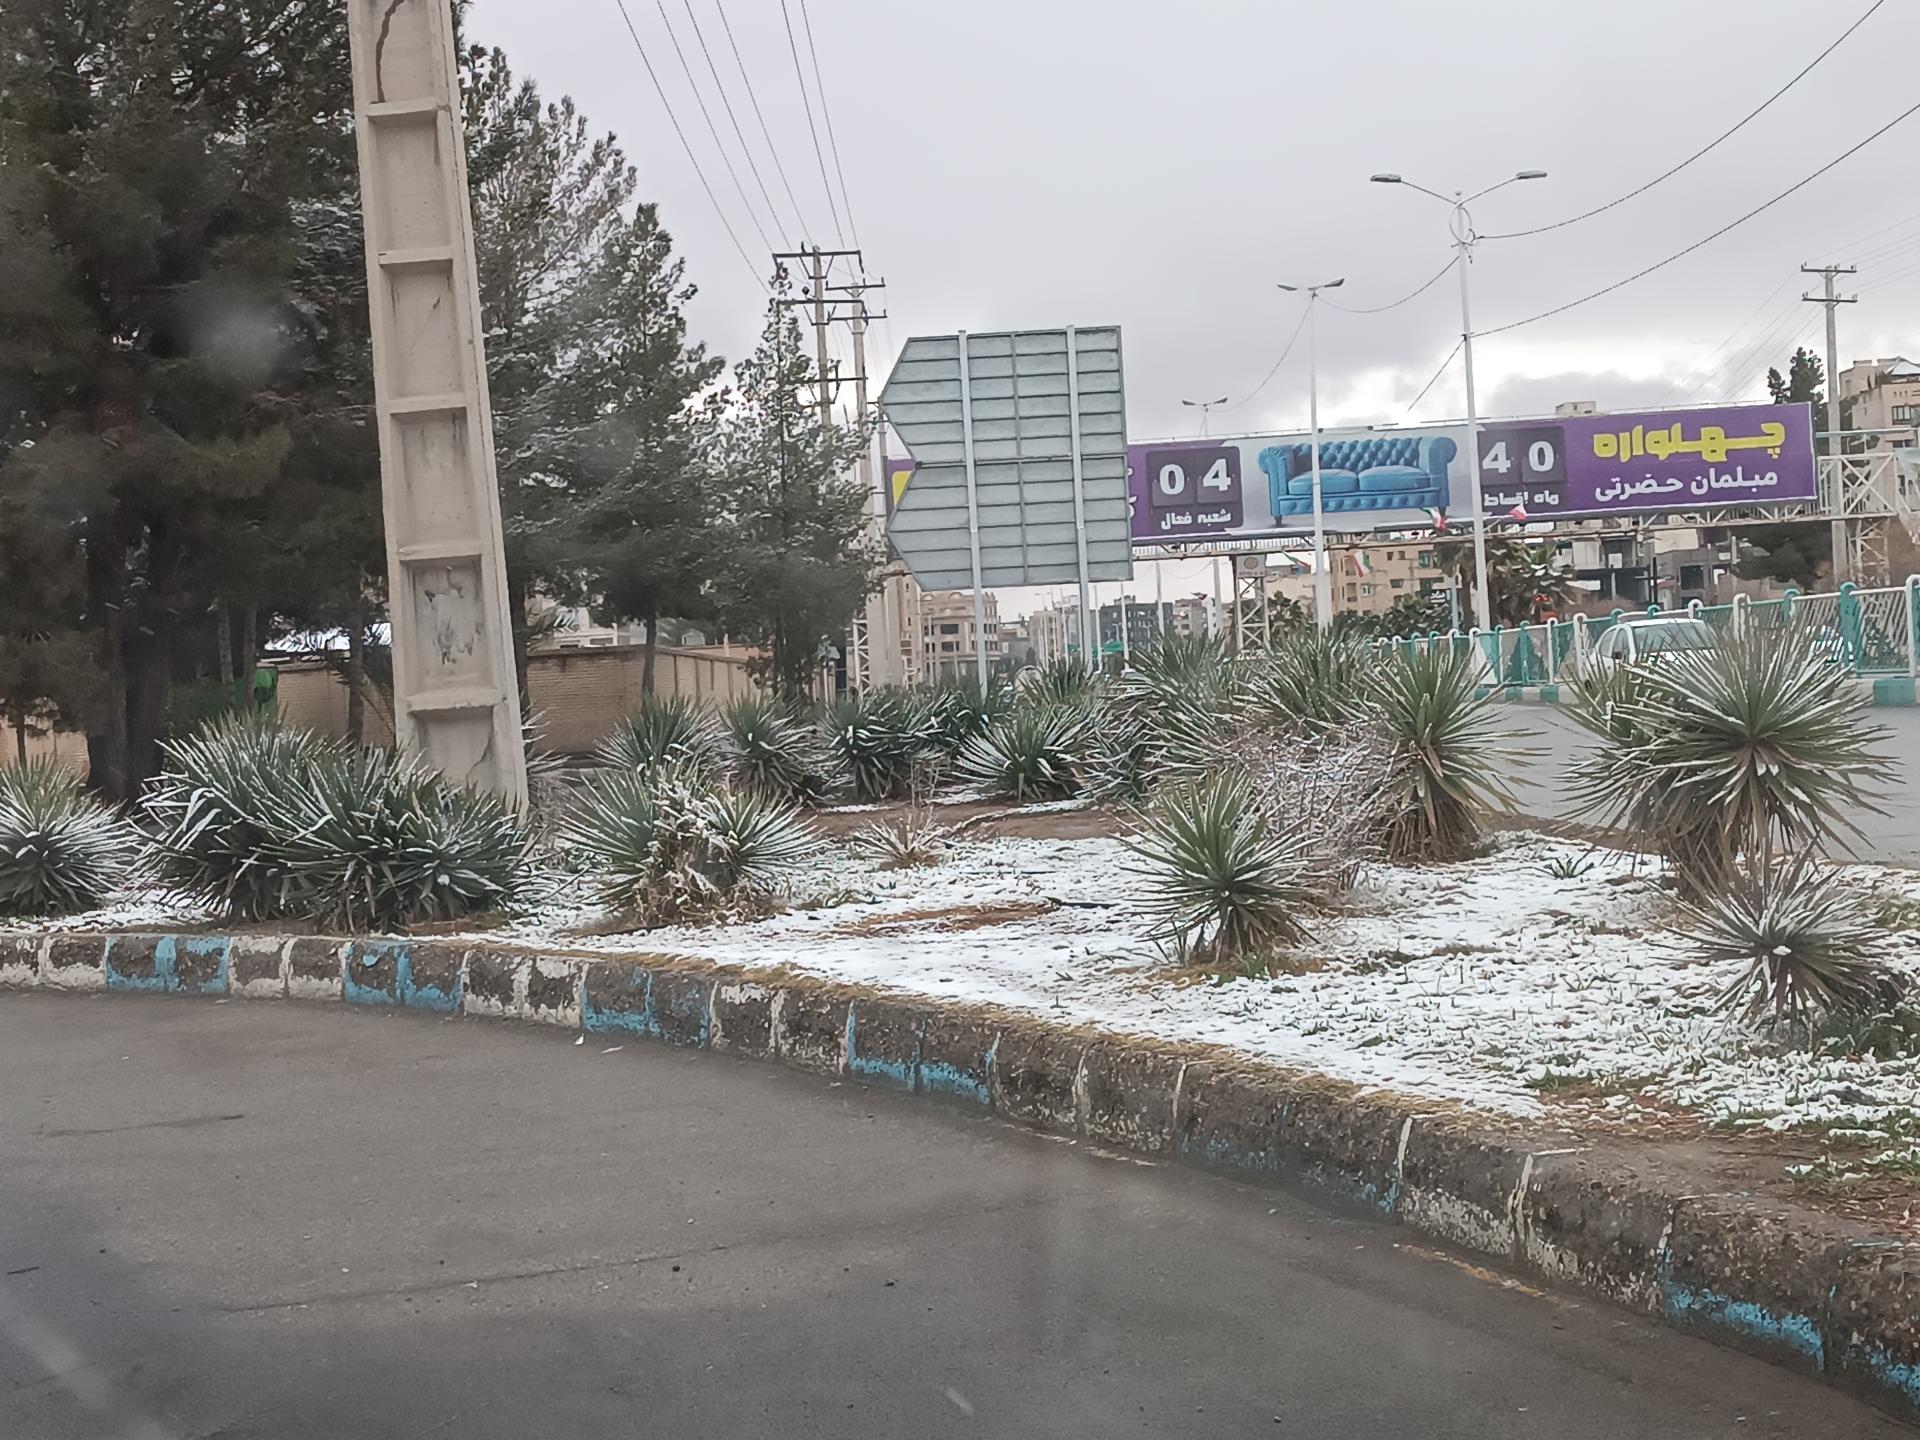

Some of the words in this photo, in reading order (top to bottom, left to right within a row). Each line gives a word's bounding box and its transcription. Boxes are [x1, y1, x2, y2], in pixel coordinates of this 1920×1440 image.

[1593, 422, 1786, 463] چهلواره
[1594, 473, 1684, 502] حضرتی
[1690, 465, 1778, 496] مبلمان
[1533, 489, 1559, 505] ماه
[1161, 511, 1192, 530] فعال
[1197, 508, 1232, 526] شعبه
